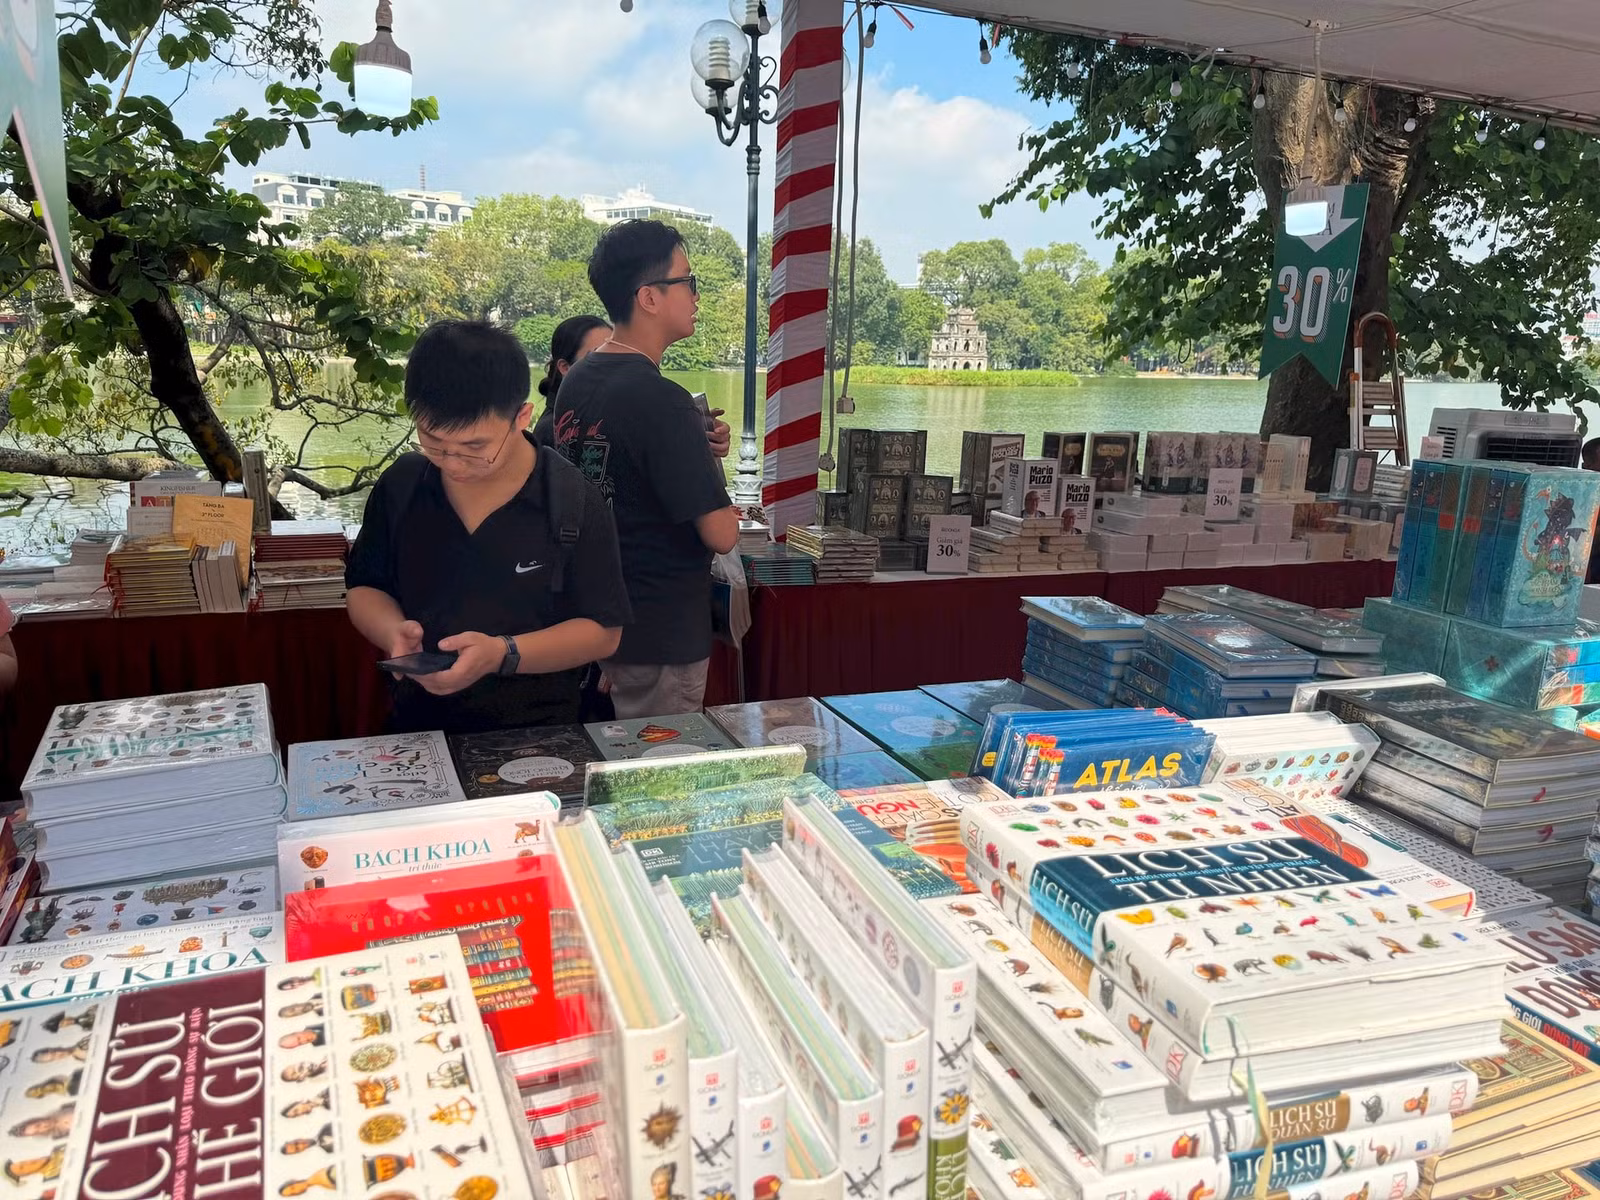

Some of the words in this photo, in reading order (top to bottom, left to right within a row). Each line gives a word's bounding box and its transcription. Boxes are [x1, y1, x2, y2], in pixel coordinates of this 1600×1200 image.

[1273, 265, 1350, 343] 30%
[1030, 465, 1053, 475] Mario
[1067, 483, 1090, 492] Mario
[936, 544, 960, 557] 30%
[1073, 752, 1182, 788] ATLAS
[353, 846, 420, 870] BÁCH
[426, 838, 492, 861] KHOA
[0, 972, 105, 1002] ÁCH
[114, 947, 272, 987] KHOA
[105, 1012, 186, 1090] SỬ
[201, 999, 264, 1106] GIỚI
[183, 1075, 195, 1103] THEO
[191, 1117, 263, 1200] HẾ
[935, 1154, 951, 1200] KHO
